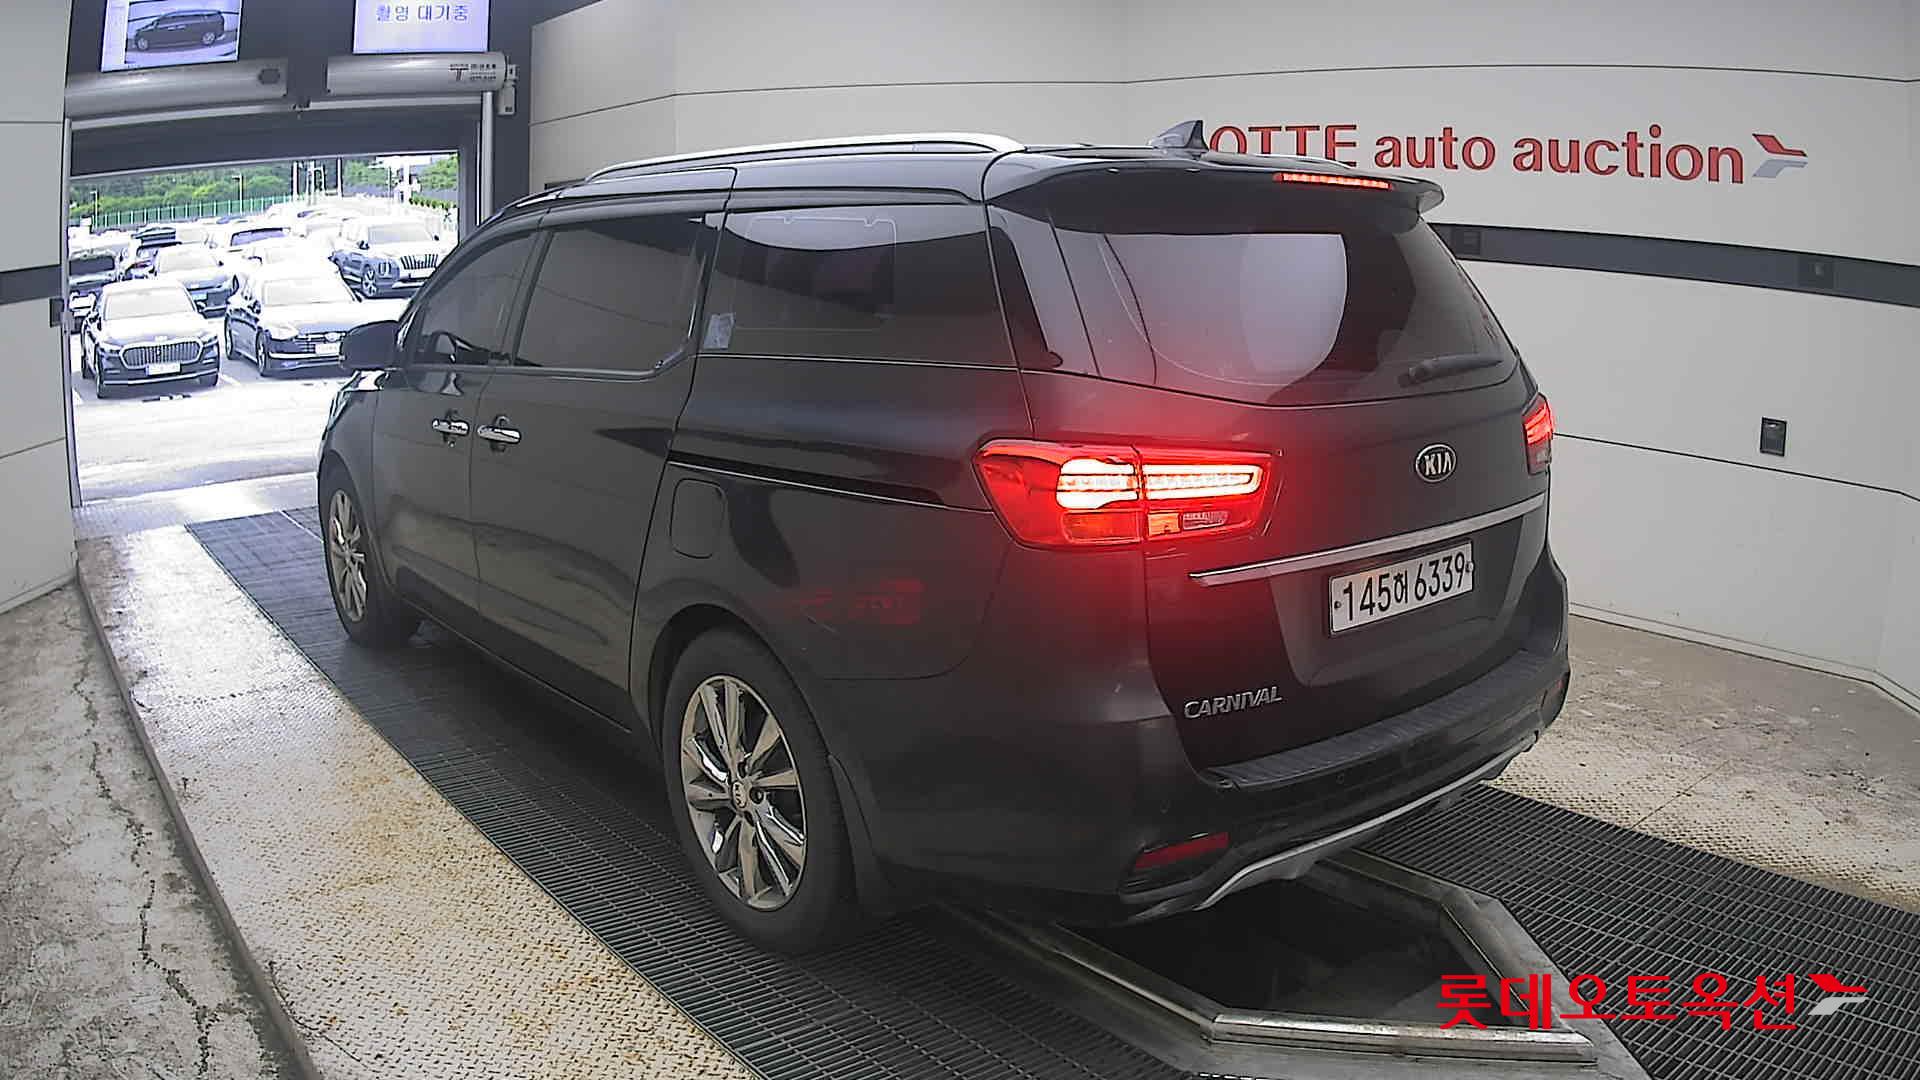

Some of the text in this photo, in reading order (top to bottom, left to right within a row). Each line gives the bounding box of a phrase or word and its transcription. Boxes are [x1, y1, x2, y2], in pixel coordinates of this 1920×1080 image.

[417, 5, 468, 21] 대기중
[1209, 124, 1745, 184] OTTE auto auction
[1422, 450, 1454, 477] KIA
[1414, 551, 1466, 601] 6339
[1184, 686, 1282, 718] CARNIVAL
